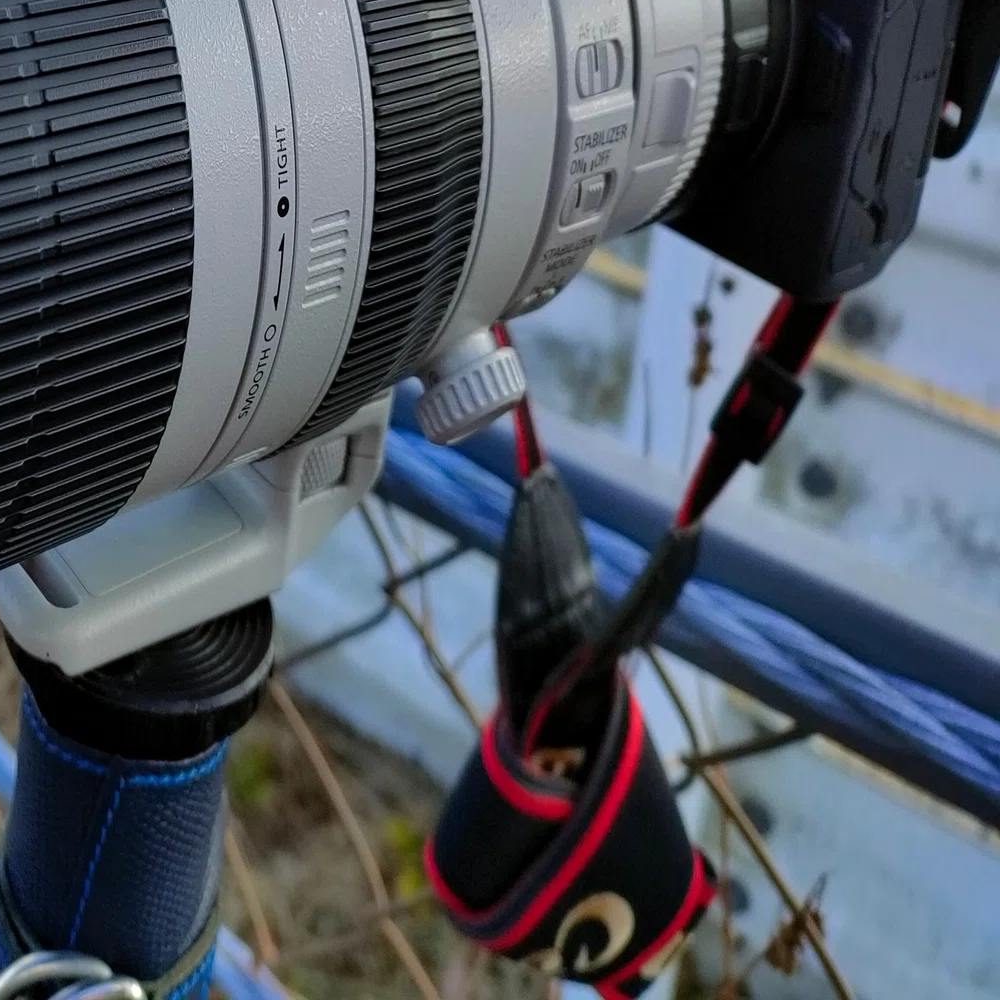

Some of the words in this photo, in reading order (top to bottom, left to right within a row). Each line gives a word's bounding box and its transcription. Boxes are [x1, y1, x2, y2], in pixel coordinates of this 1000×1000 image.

[573, 123, 628, 154] STABILIZER
[569, 158, 585, 176] ON
[594, 148, 613, 168] OFF
[237, 347, 272, 421] SMOOTH
[274, 124, 289, 189] TIGHT
